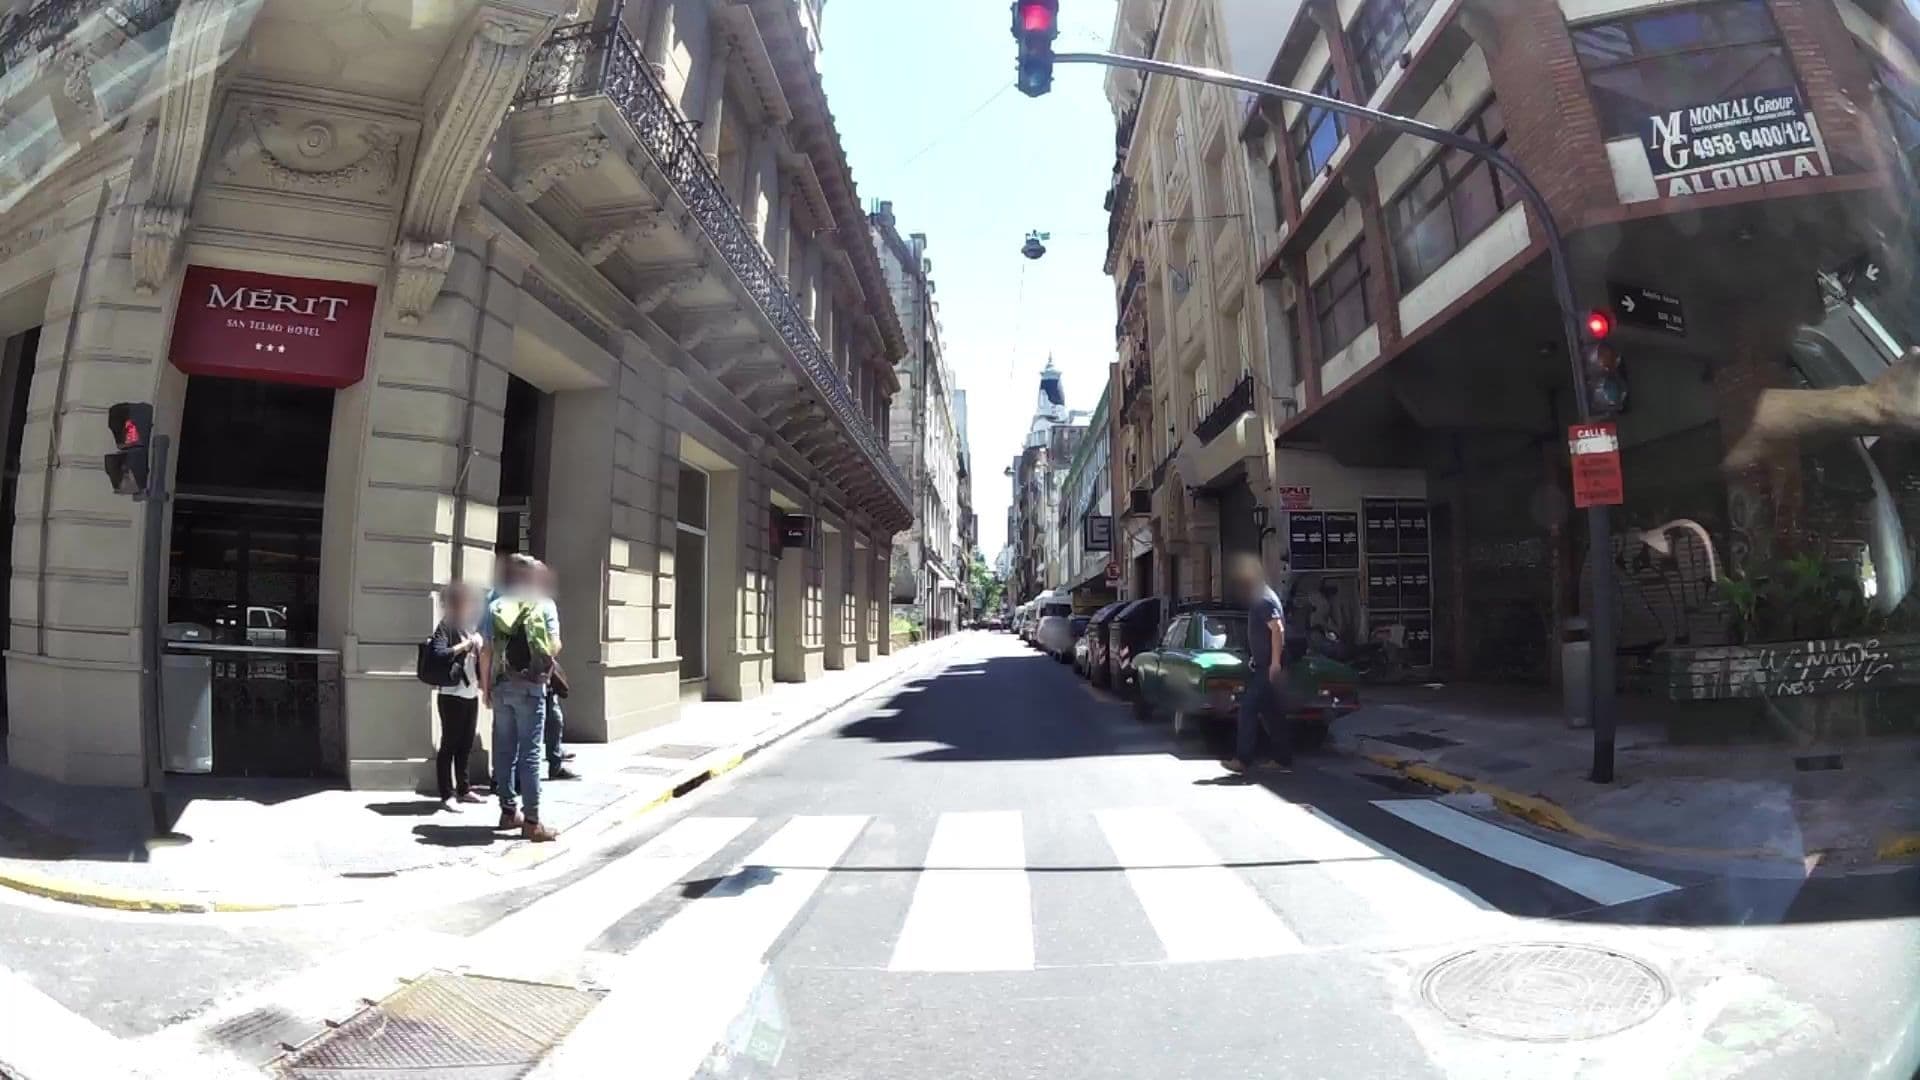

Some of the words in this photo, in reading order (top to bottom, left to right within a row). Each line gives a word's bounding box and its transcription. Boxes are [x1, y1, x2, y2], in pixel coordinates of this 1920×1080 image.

[1689, 98, 1752, 126] MONTAL
[1693, 122, 1811, 159] 4958-6400/1/2
[1669, 155, 1819, 196] ALQUILA
[227, 318, 245, 328] SAN
[250, 320, 284, 333] TELMO
[287, 325, 321, 337] HOTEL
[1577, 429, 1607, 438] CALLE
